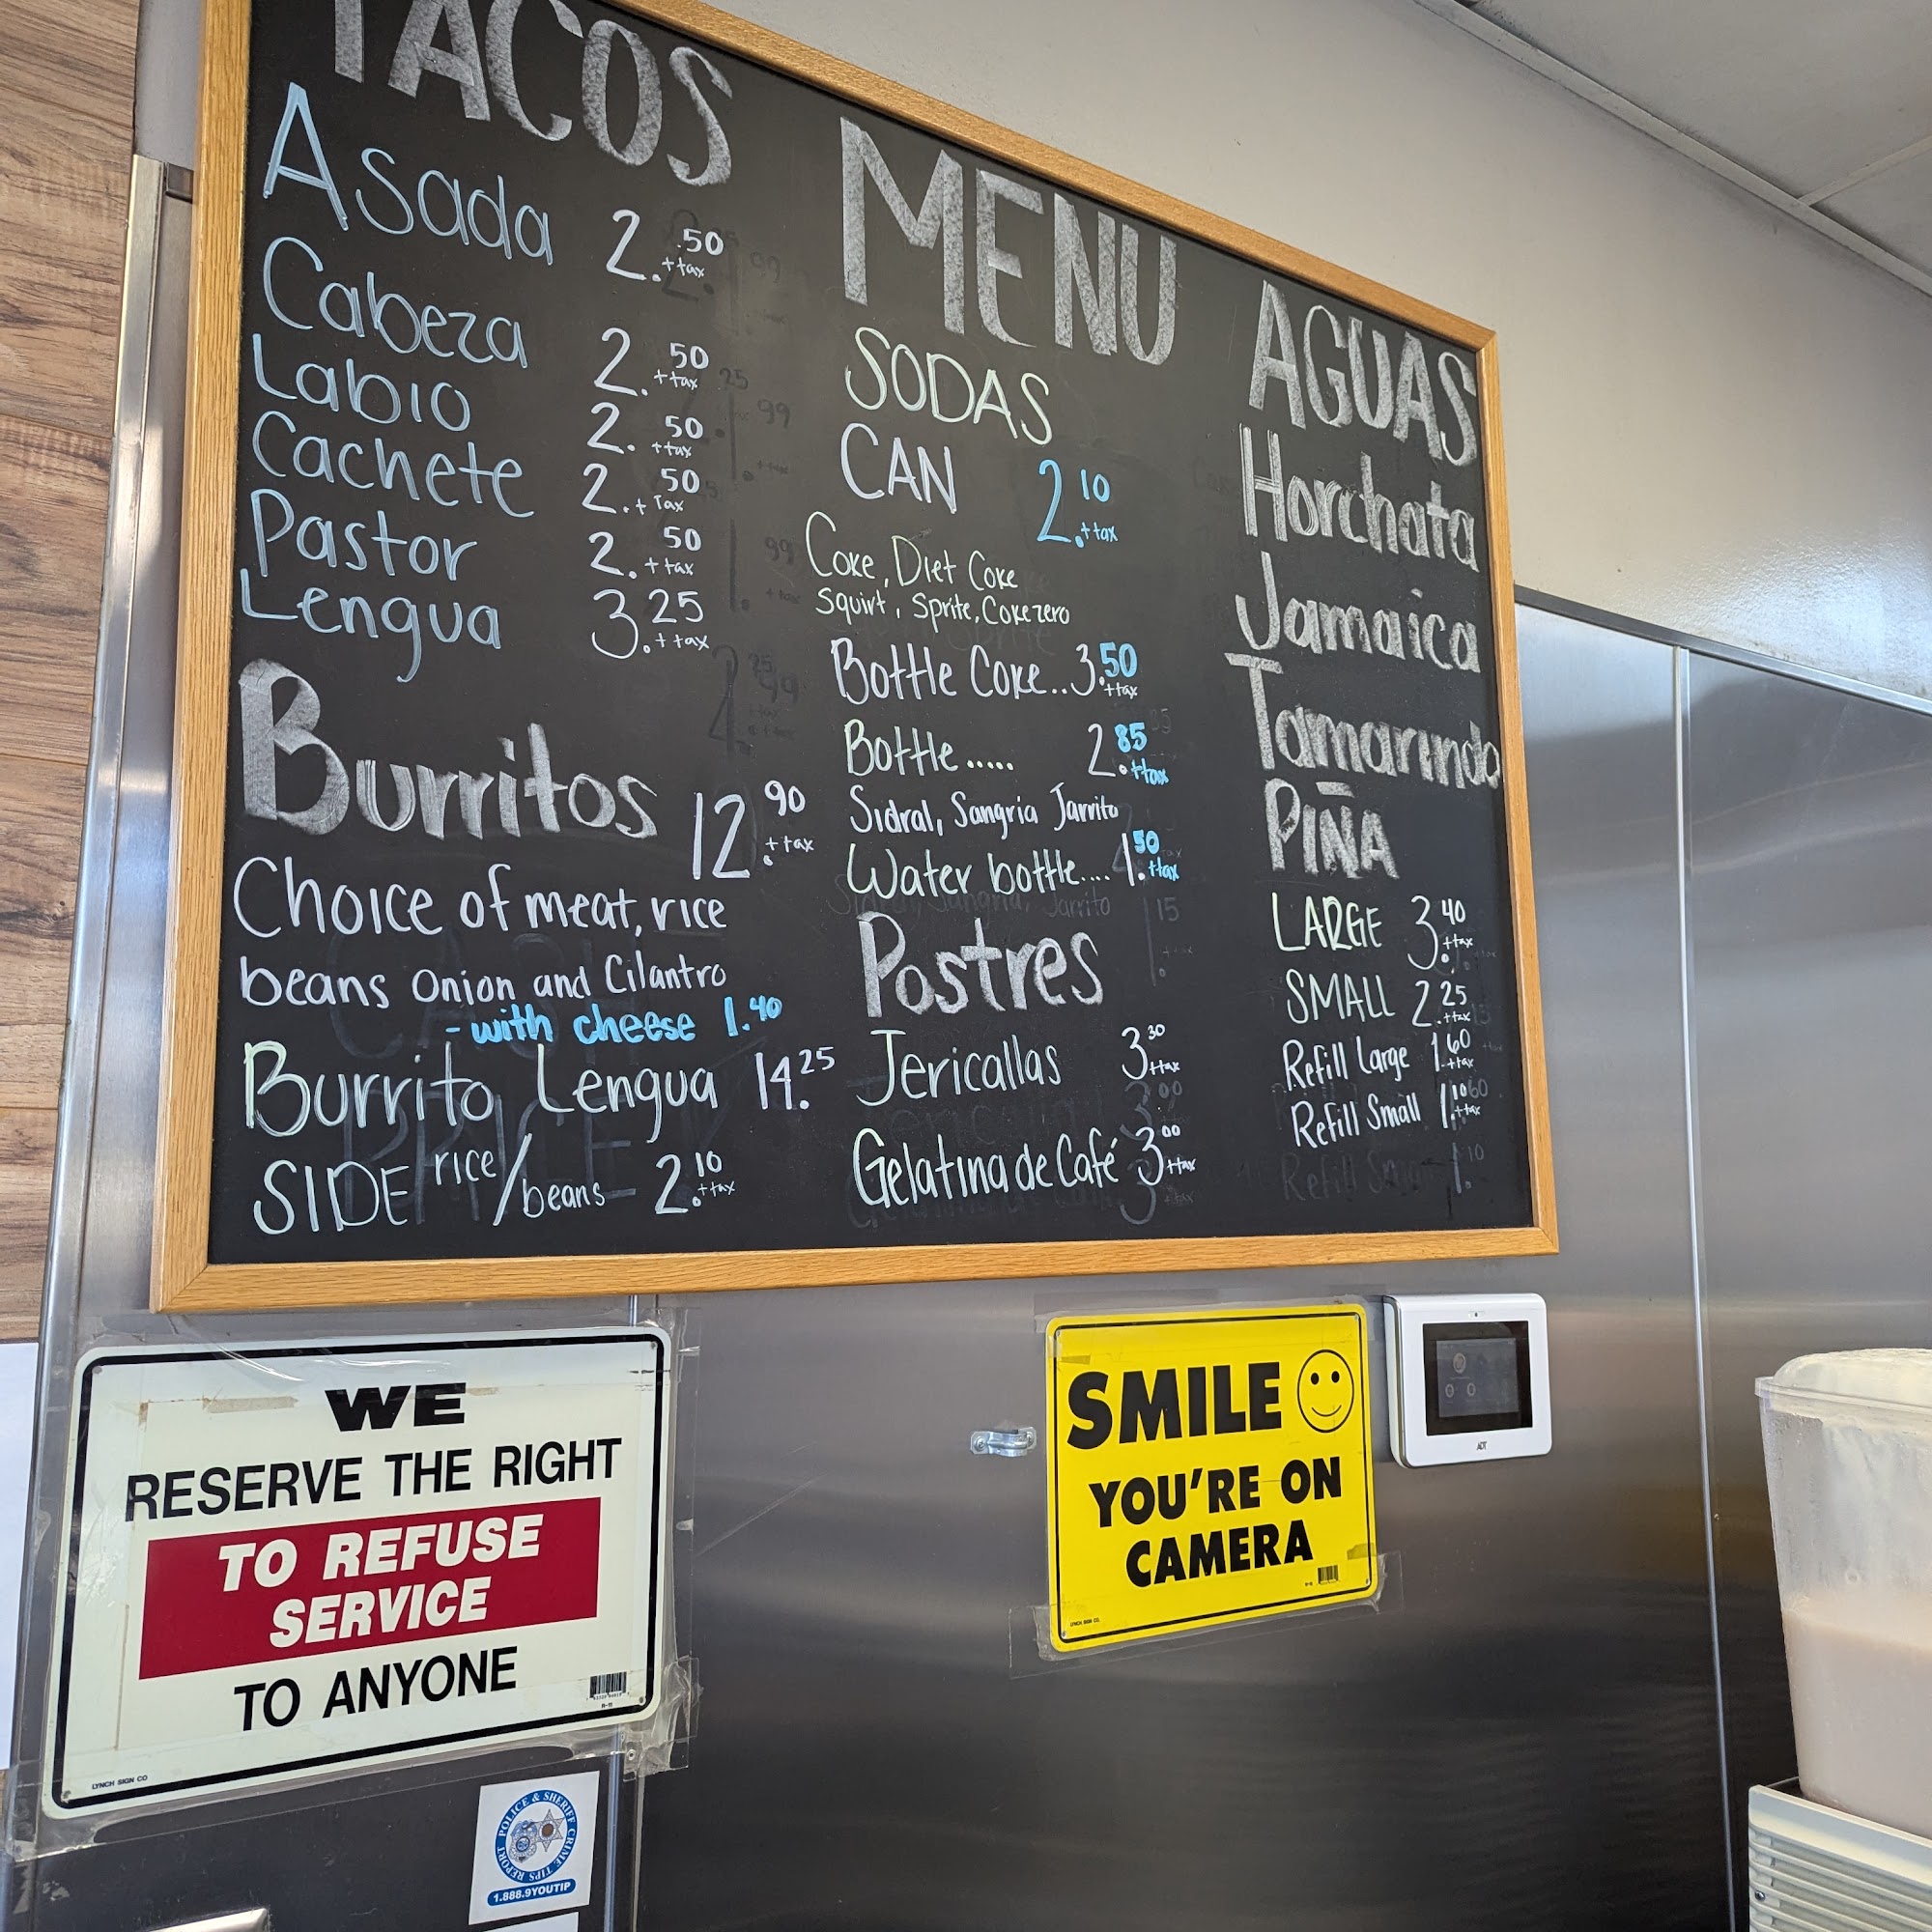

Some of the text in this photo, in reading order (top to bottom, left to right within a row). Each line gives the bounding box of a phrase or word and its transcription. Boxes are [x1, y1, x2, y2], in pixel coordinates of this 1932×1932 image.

[262, 82, 554, 266] Asada
[839, 116, 1178, 365] MENU
[263, 237, 527, 368] Cabeza
[252, 334, 470, 432] Labio
[844, 327, 1052, 445] SODAS
[1248, 279, 1477, 467] AGUAS
[252, 410, 534, 518] Cachete
[840, 422, 957, 514] CAN
[1238, 422, 1479, 573] Horchata
[249, 488, 477, 581] Pastor
[891, 535, 957, 587] Diet
[968, 550, 1019, 591] Coke
[240, 568, 501, 683] Lengua
[1235, 550, 1480, 673] Jamaica
[831, 637, 957, 705] Bottle
[239, 658, 658, 839] Burritos
[1224, 651, 1500, 789] Tamarindo
[950, 790, 1038, 839] Sangria
[1049, 781, 1119, 831] Jarrito
[233, 856, 443, 939] Choice
[459, 864, 512, 931] of
[650, 895, 727, 932] rice
[846, 842, 974, 899] Water
[1271, 892, 1382, 951] LARGE
[240, 949, 726, 1009] beans Onion and Cilantro
[856, 911, 1104, 1017] Postres
[1286, 968, 1396, 1024] SMALL
[470, 1009, 554, 1043] with
[573, 1003, 696, 1043] cheese
[1282, 1038, 1349, 1092] Refill
[1355, 1035, 1410, 1082] Large
[243, 1039, 494, 1138] Burrito
[536, 1041, 718, 1144] Lengua
[856, 1029, 1062, 1107] Jericallas
[1291, 1099, 1360, 1149] Refill
[1366, 1092, 1421, 1130] Small
[252, 1159, 409, 1235] SIDE
[852, 1126, 1009, 1208] Gelatina
[1014, 1143, 1054, 1191] de
[1056, 1126, 1119, 1188] Café
[324, 1381, 466, 1433] WE
[1066, 1360, 1283, 1451] SMILE
[125, 1436, 622, 1522] RESERVE THE RIGHT
[1088, 1456, 1342, 1528] YOU'RE ON
[217, 1513, 545, 1592] TO REFUSE
[1125, 1519, 1314, 1588] CAMERA
[270, 1576, 492, 1649] SERVICE
[234, 1645, 518, 1731] TO ANYONE
[92, 1780, 115, 1790] LYNCH
[117, 1776, 134, 1785] SIGN
[497, 1791, 577, 1882] POLICE & SHERIFF CRIME TIPS REPORT
[493, 1881, 571, 1903] 1.888.9YOUTIP
